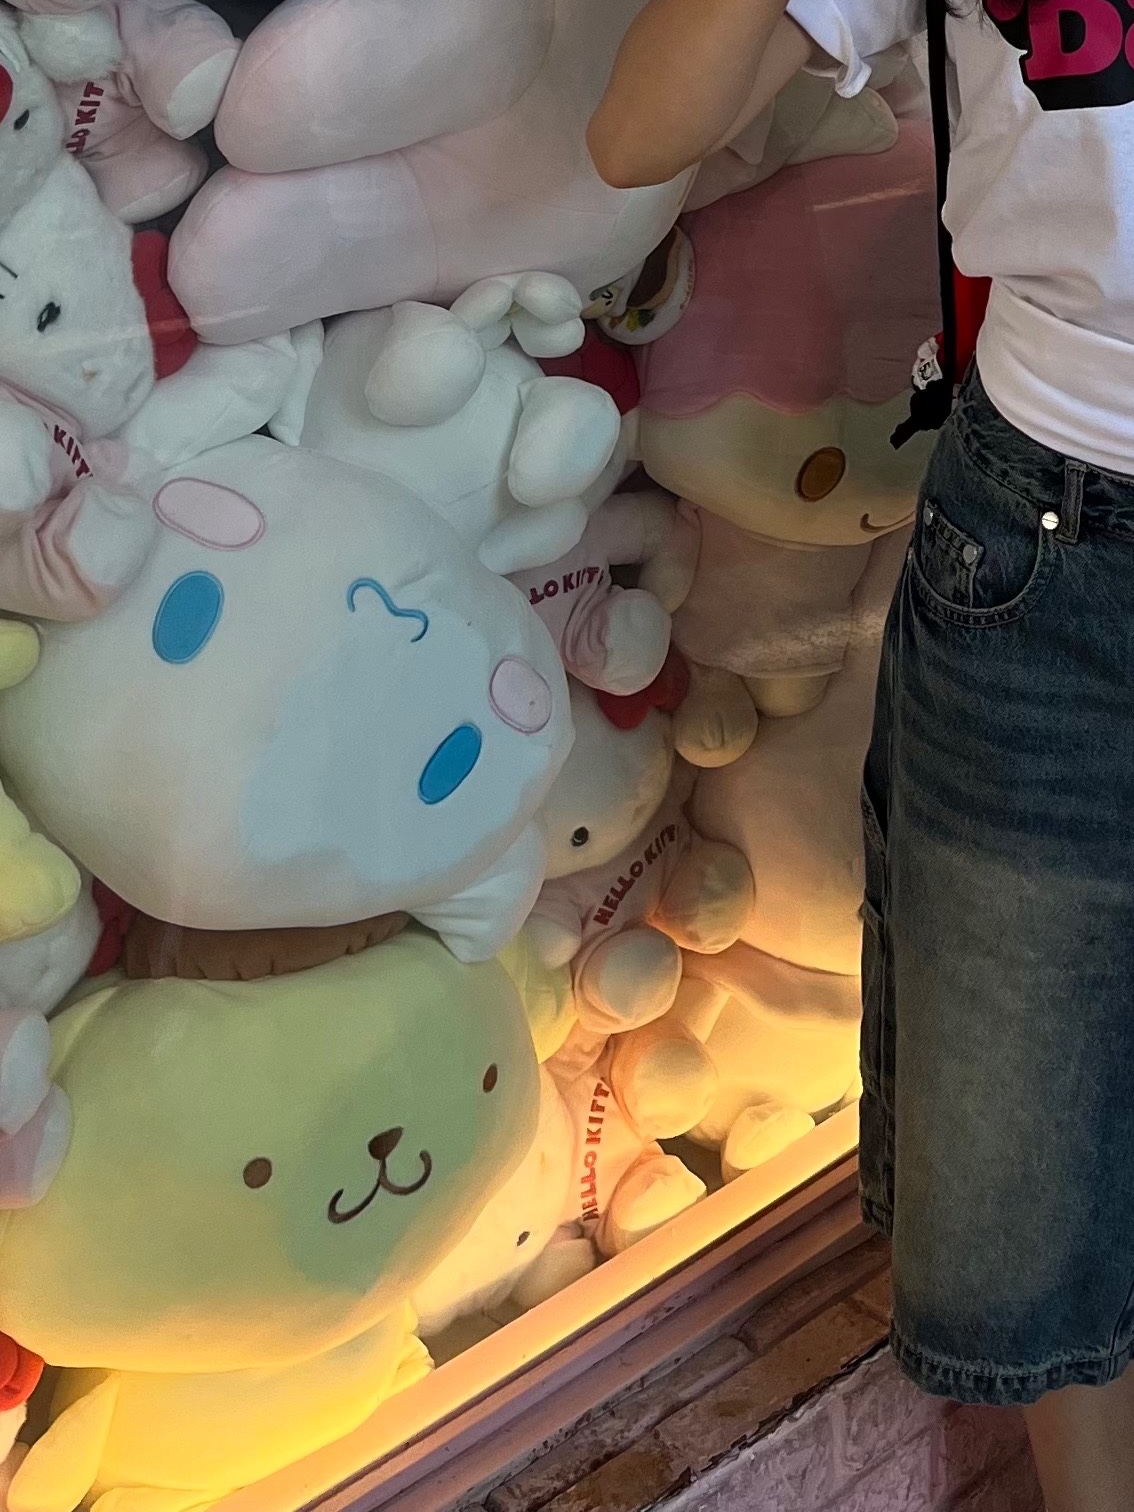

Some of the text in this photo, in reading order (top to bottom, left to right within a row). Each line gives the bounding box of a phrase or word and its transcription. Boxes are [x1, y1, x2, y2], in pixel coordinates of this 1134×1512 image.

[75, 81, 104, 126] KIT
[53, 424, 91, 478] KITT
[593, 860, 644, 926] HELLO
[580, 1150, 600, 1222] HELLO
